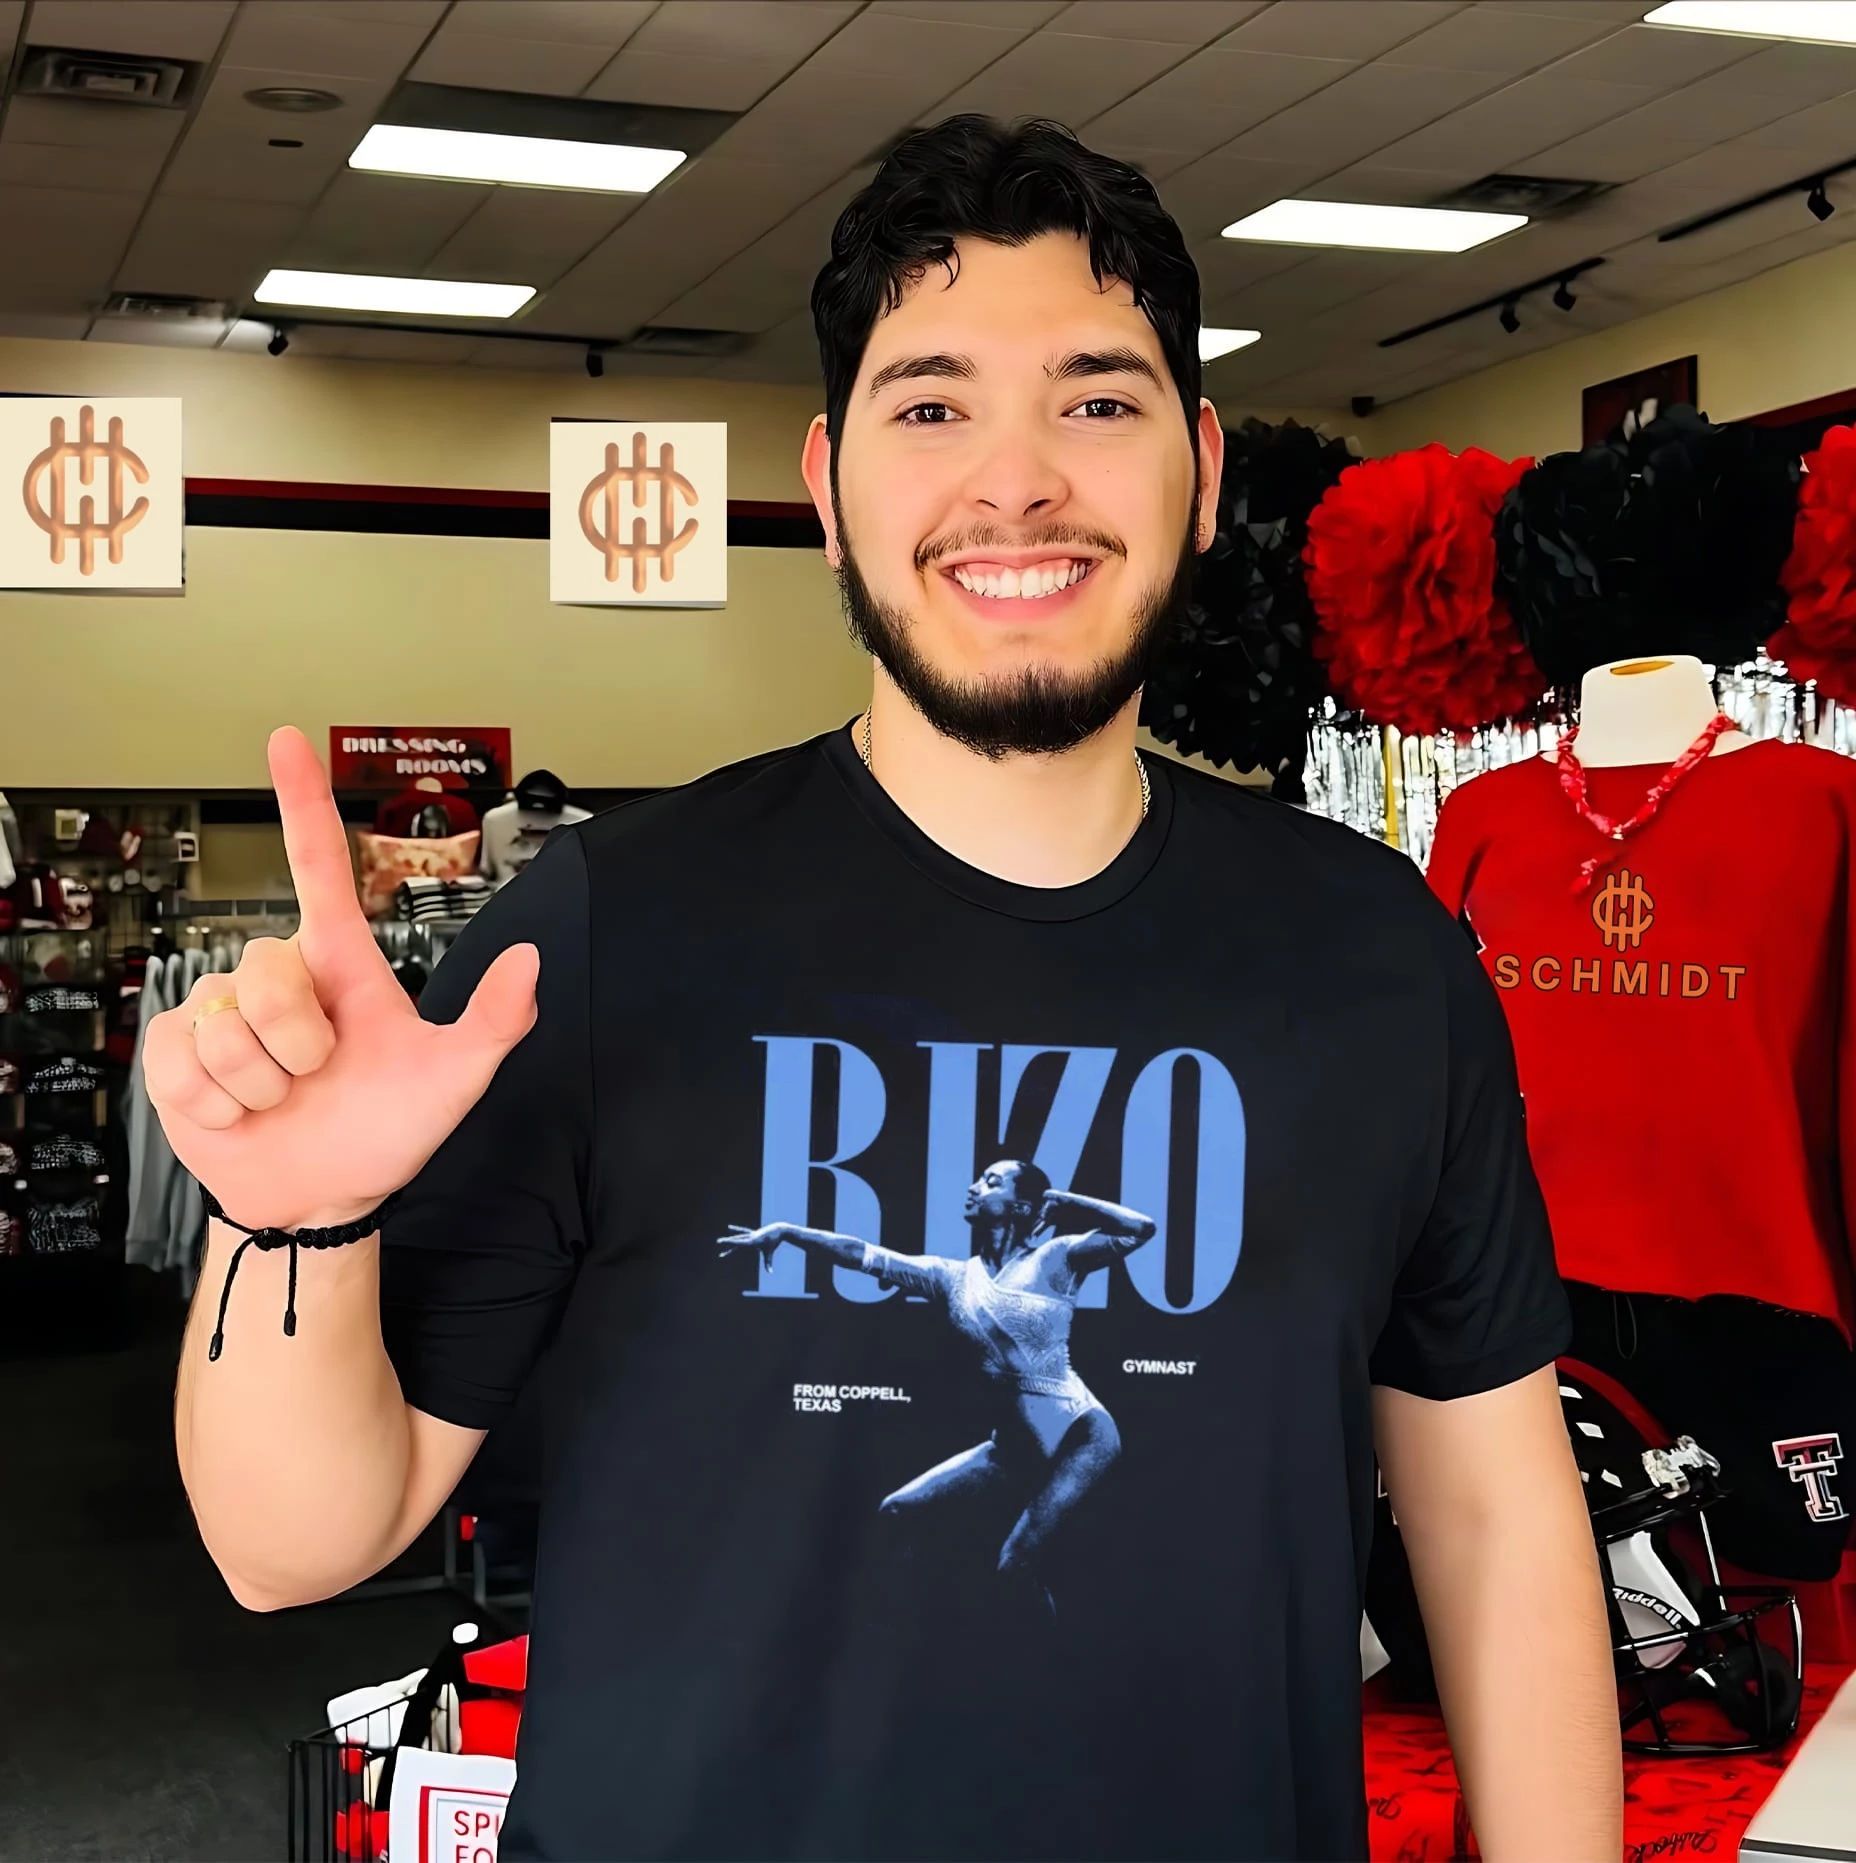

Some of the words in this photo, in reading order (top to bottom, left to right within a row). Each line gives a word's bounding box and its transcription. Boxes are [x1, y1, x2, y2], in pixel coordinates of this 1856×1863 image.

[396, 758, 487, 774] ROOMS
[1494, 955, 1746, 999] SCHMIDT
[742, 1035, 1246, 1315] RIZO
[1122, 1359, 1197, 1375] GYMNAST
[793, 1383, 836, 1398] FROM
[838, 1385, 911, 1403] COPPELL,
[793, 1398, 842, 1413] TEXAS
